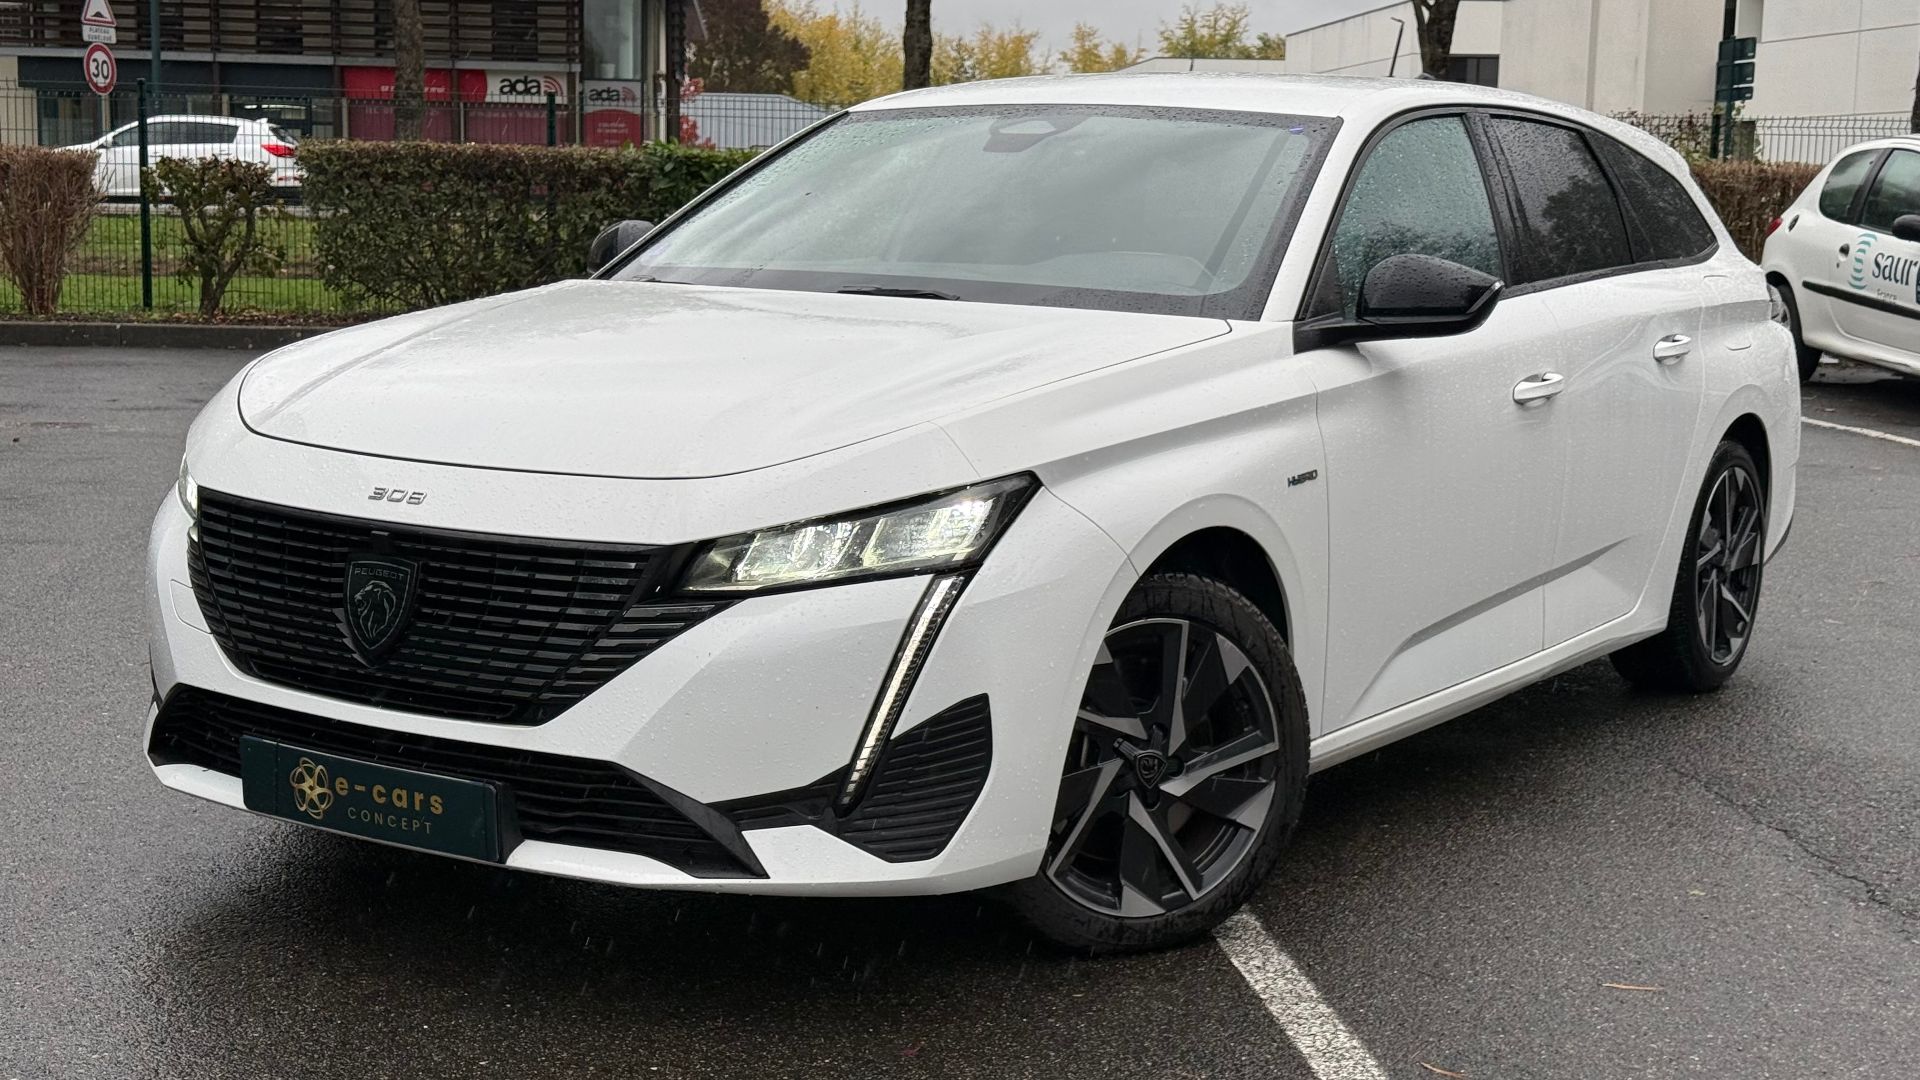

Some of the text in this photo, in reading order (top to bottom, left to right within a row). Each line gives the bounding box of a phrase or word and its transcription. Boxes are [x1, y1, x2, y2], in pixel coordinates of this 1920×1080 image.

[92, 58, 109, 79] 30
[500, 76, 541, 95] ada
[589, 87, 620, 102] ada
[1872, 252, 1918, 286] saur
[368, 486, 428, 505] 308
[355, 567, 405, 580] PEUGEOT
[335, 776, 444, 815] e-cars
[347, 806, 432, 835] CONCEPT
